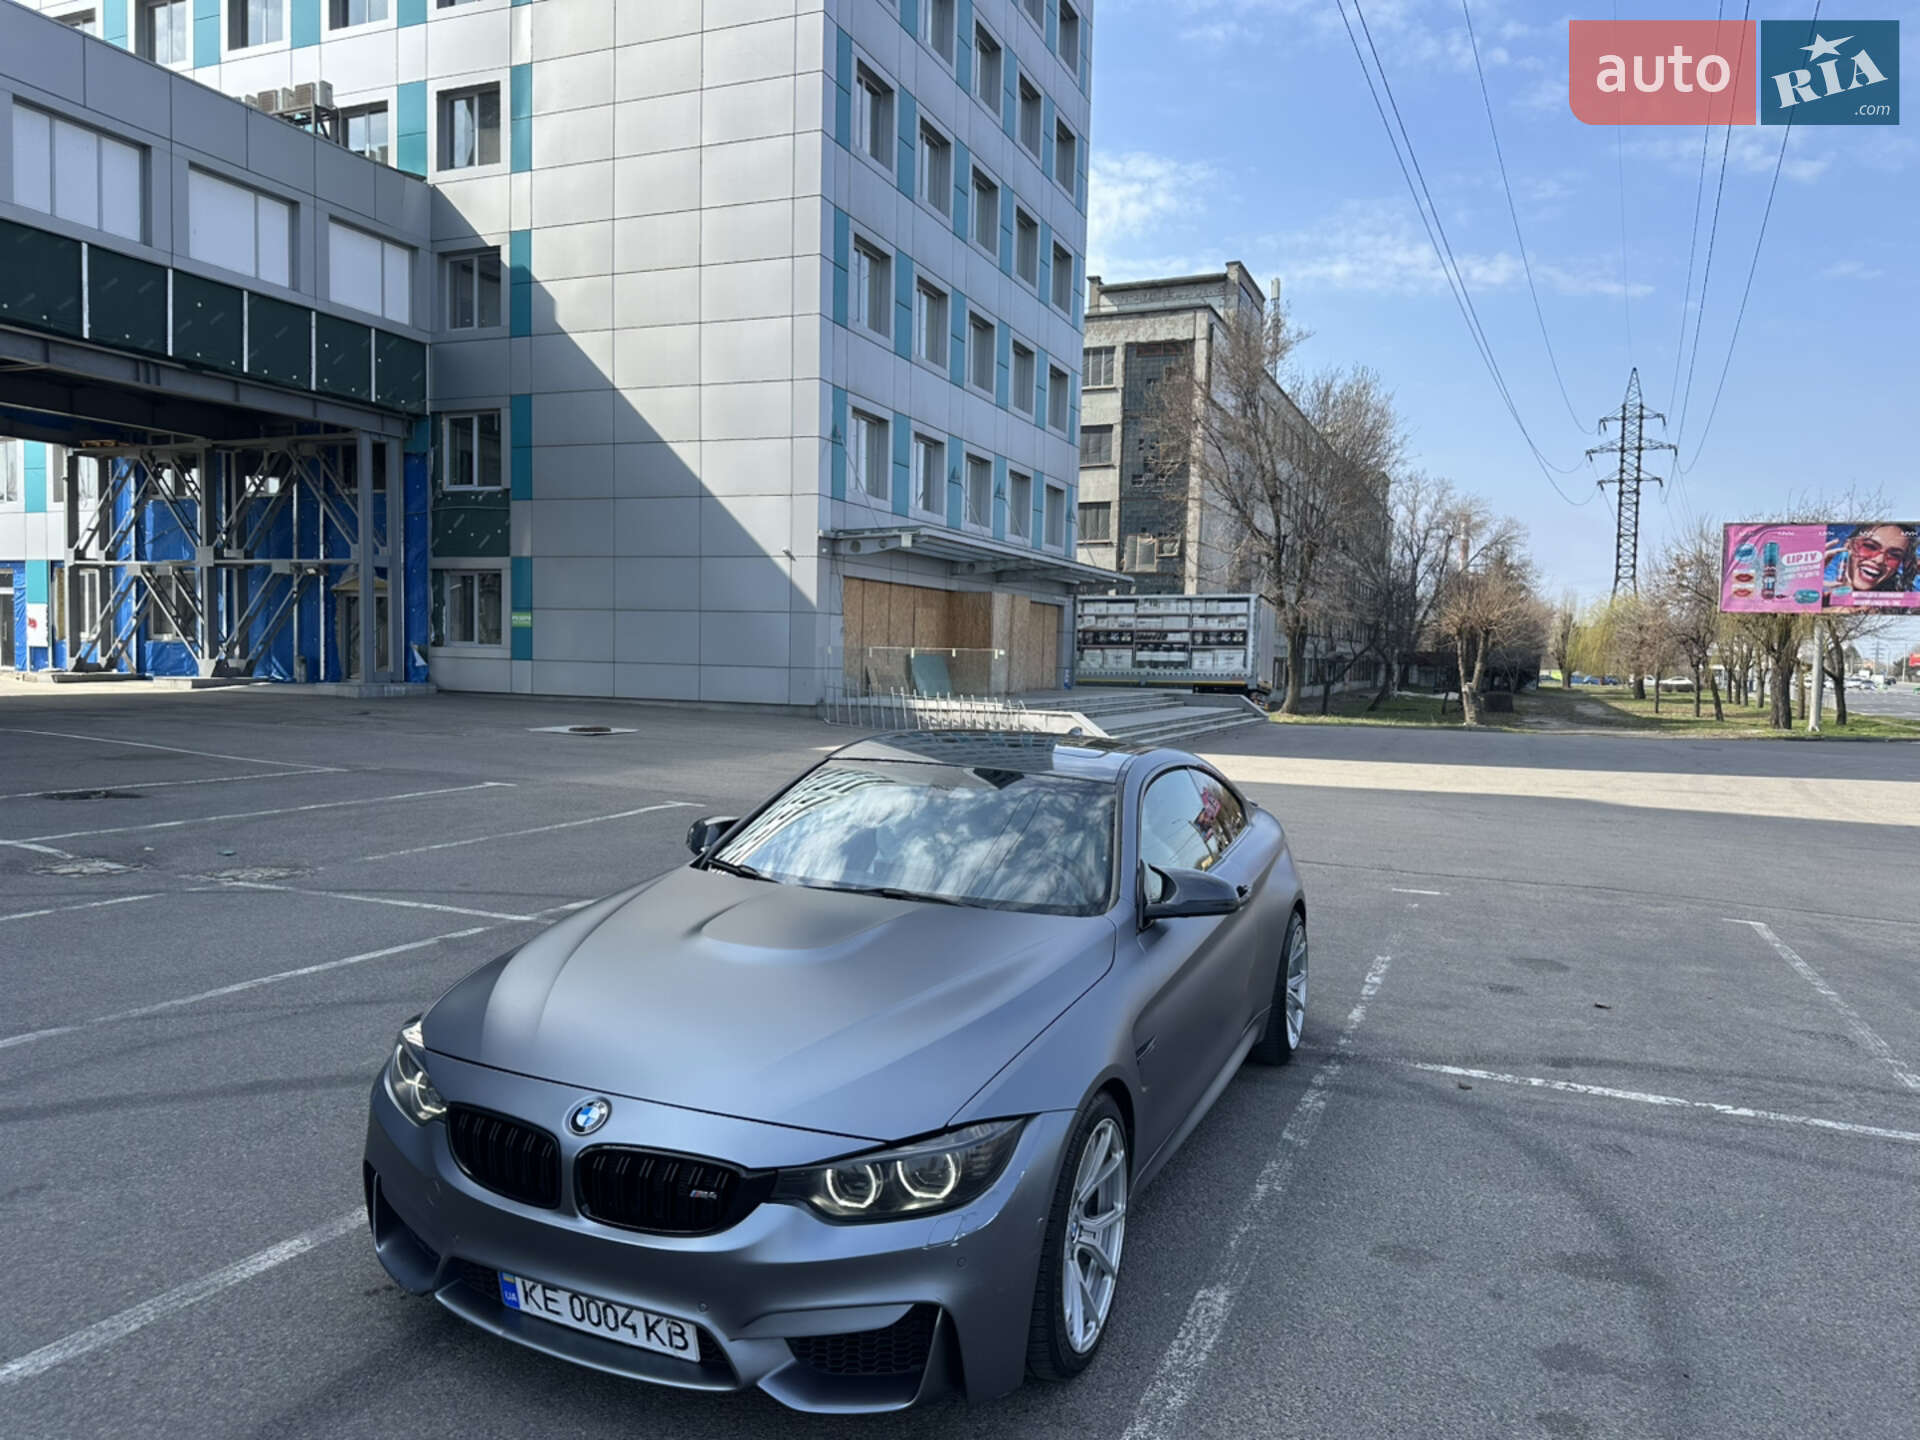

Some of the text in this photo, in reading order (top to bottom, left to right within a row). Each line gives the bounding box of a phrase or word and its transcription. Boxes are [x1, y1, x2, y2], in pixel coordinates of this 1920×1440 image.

[504, 1291, 518, 1302] UA
[521, 1279, 689, 1352] KE 0004 KB
